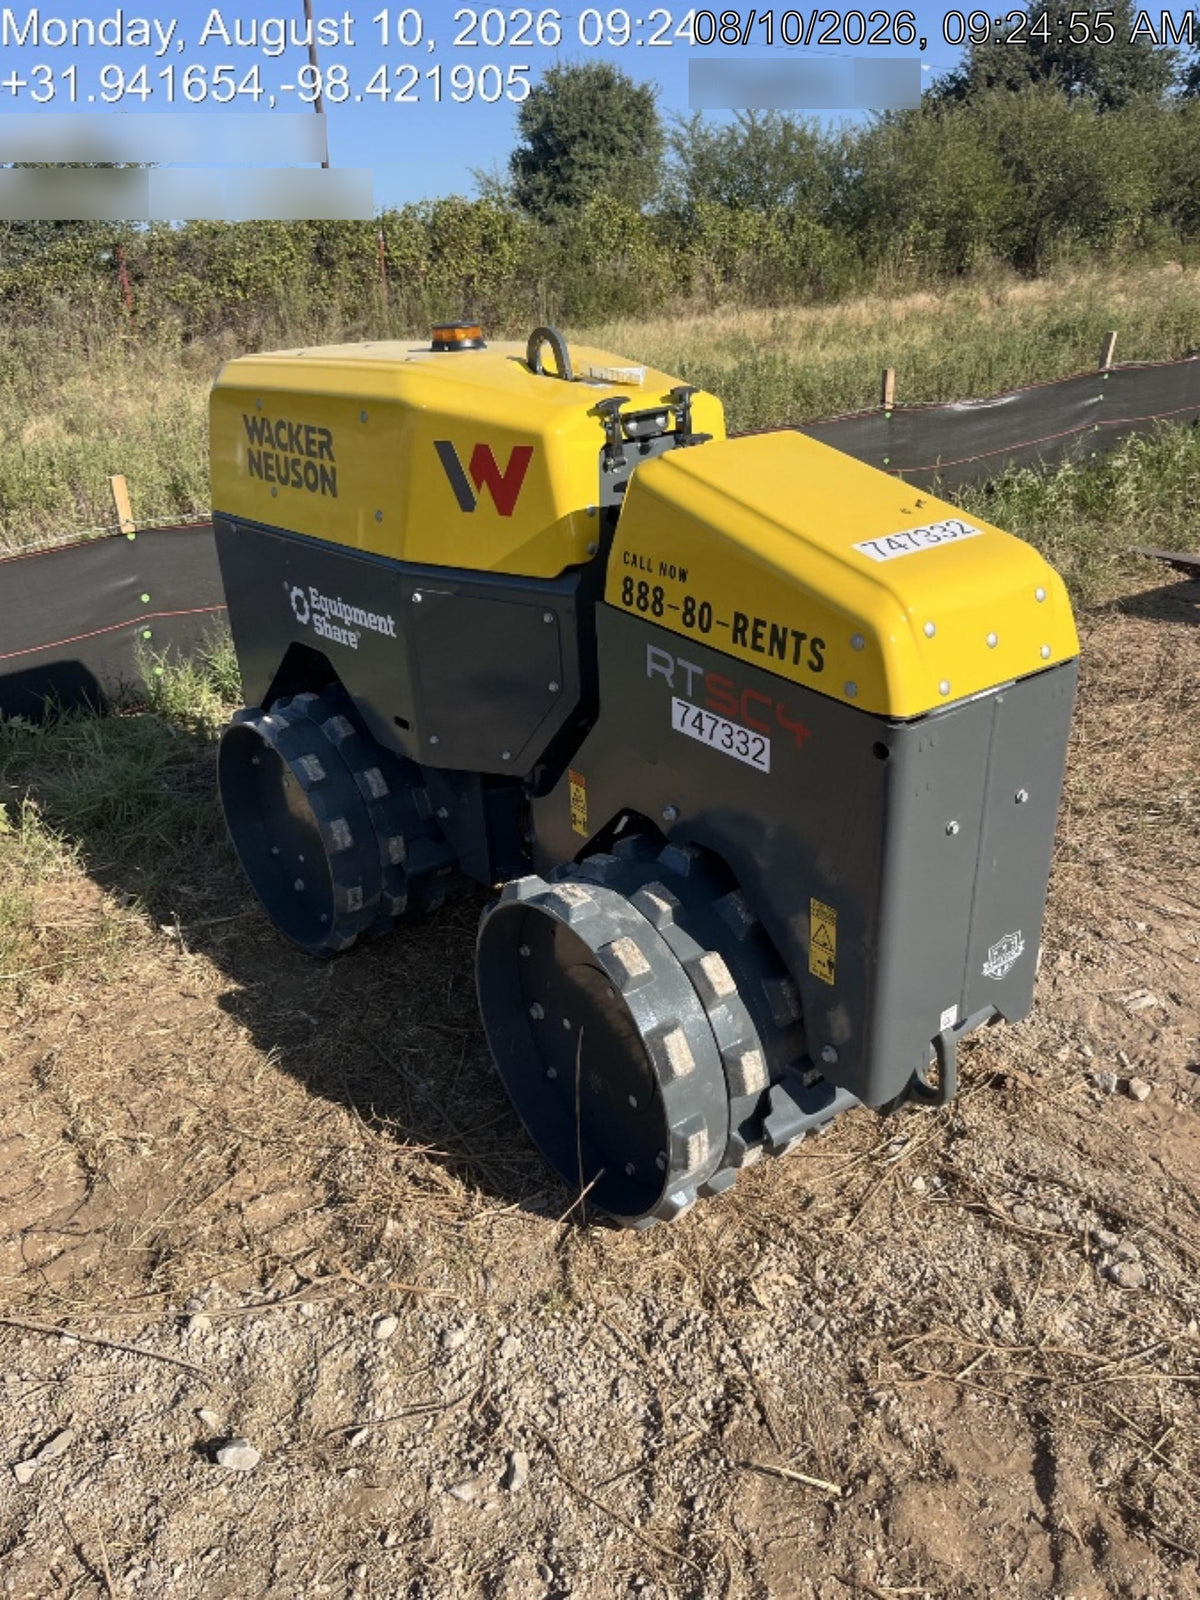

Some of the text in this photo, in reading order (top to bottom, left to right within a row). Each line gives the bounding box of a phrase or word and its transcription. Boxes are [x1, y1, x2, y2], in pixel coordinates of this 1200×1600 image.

[242, 414, 336, 463] WACKER
[247, 448, 338, 498] NEUSON
[860, 520, 976, 557] 747332
[623, 551, 690, 583] CALL NOW
[308, 586, 397, 638] Equipment
[621, 576, 827, 673] 888-80-RENTS
[676, 701, 766, 766] 747332
